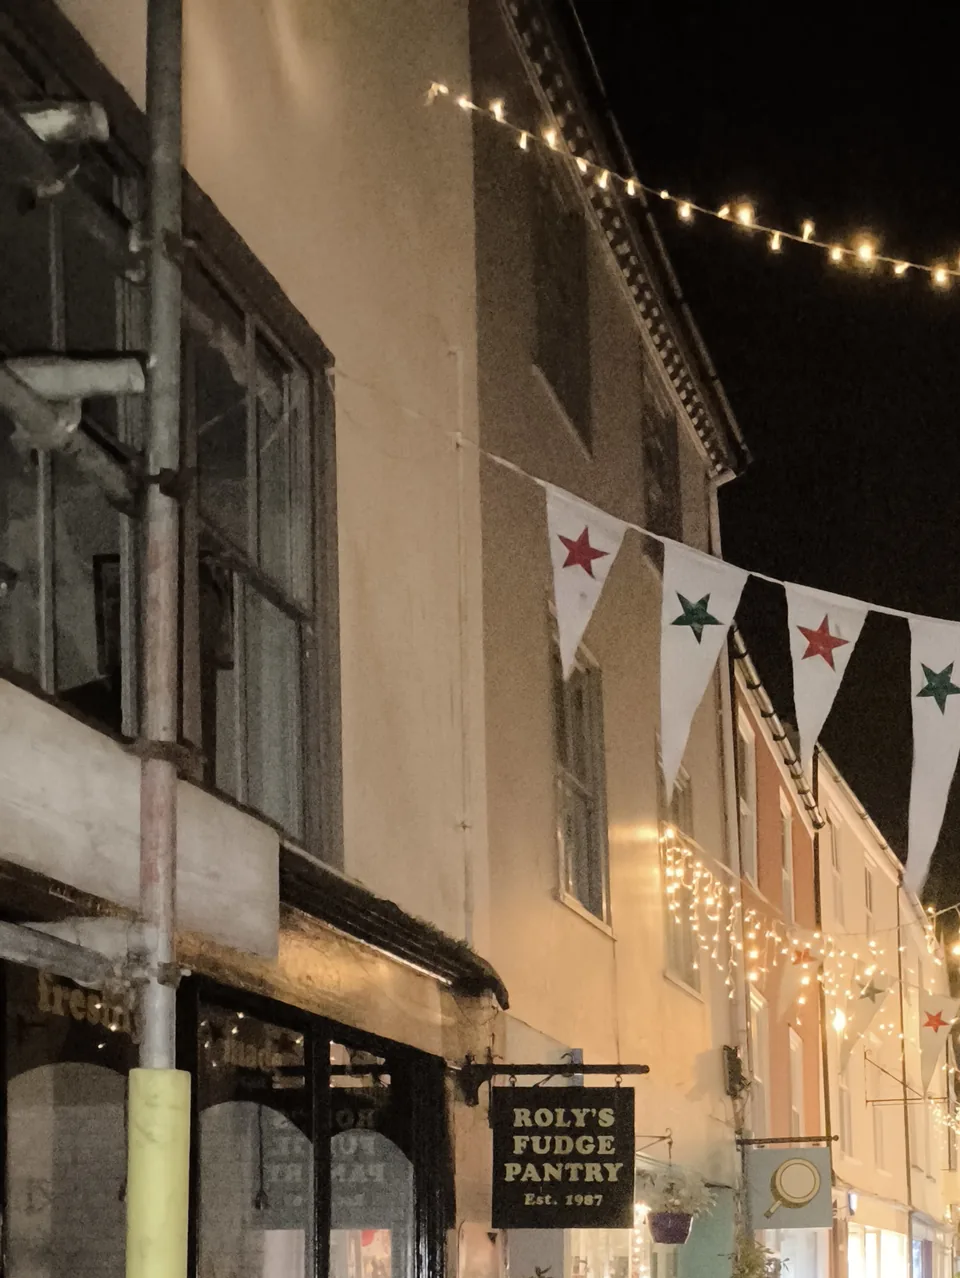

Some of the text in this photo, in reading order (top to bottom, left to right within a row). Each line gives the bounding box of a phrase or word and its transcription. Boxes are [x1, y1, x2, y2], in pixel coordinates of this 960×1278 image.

[513, 1107, 615, 1128] ROLY'S
[512, 1135, 616, 1155] FUDGE
[504, 1162, 623, 1183] PANTRY
[524, 1193, 603, 1206] Est. 1987
